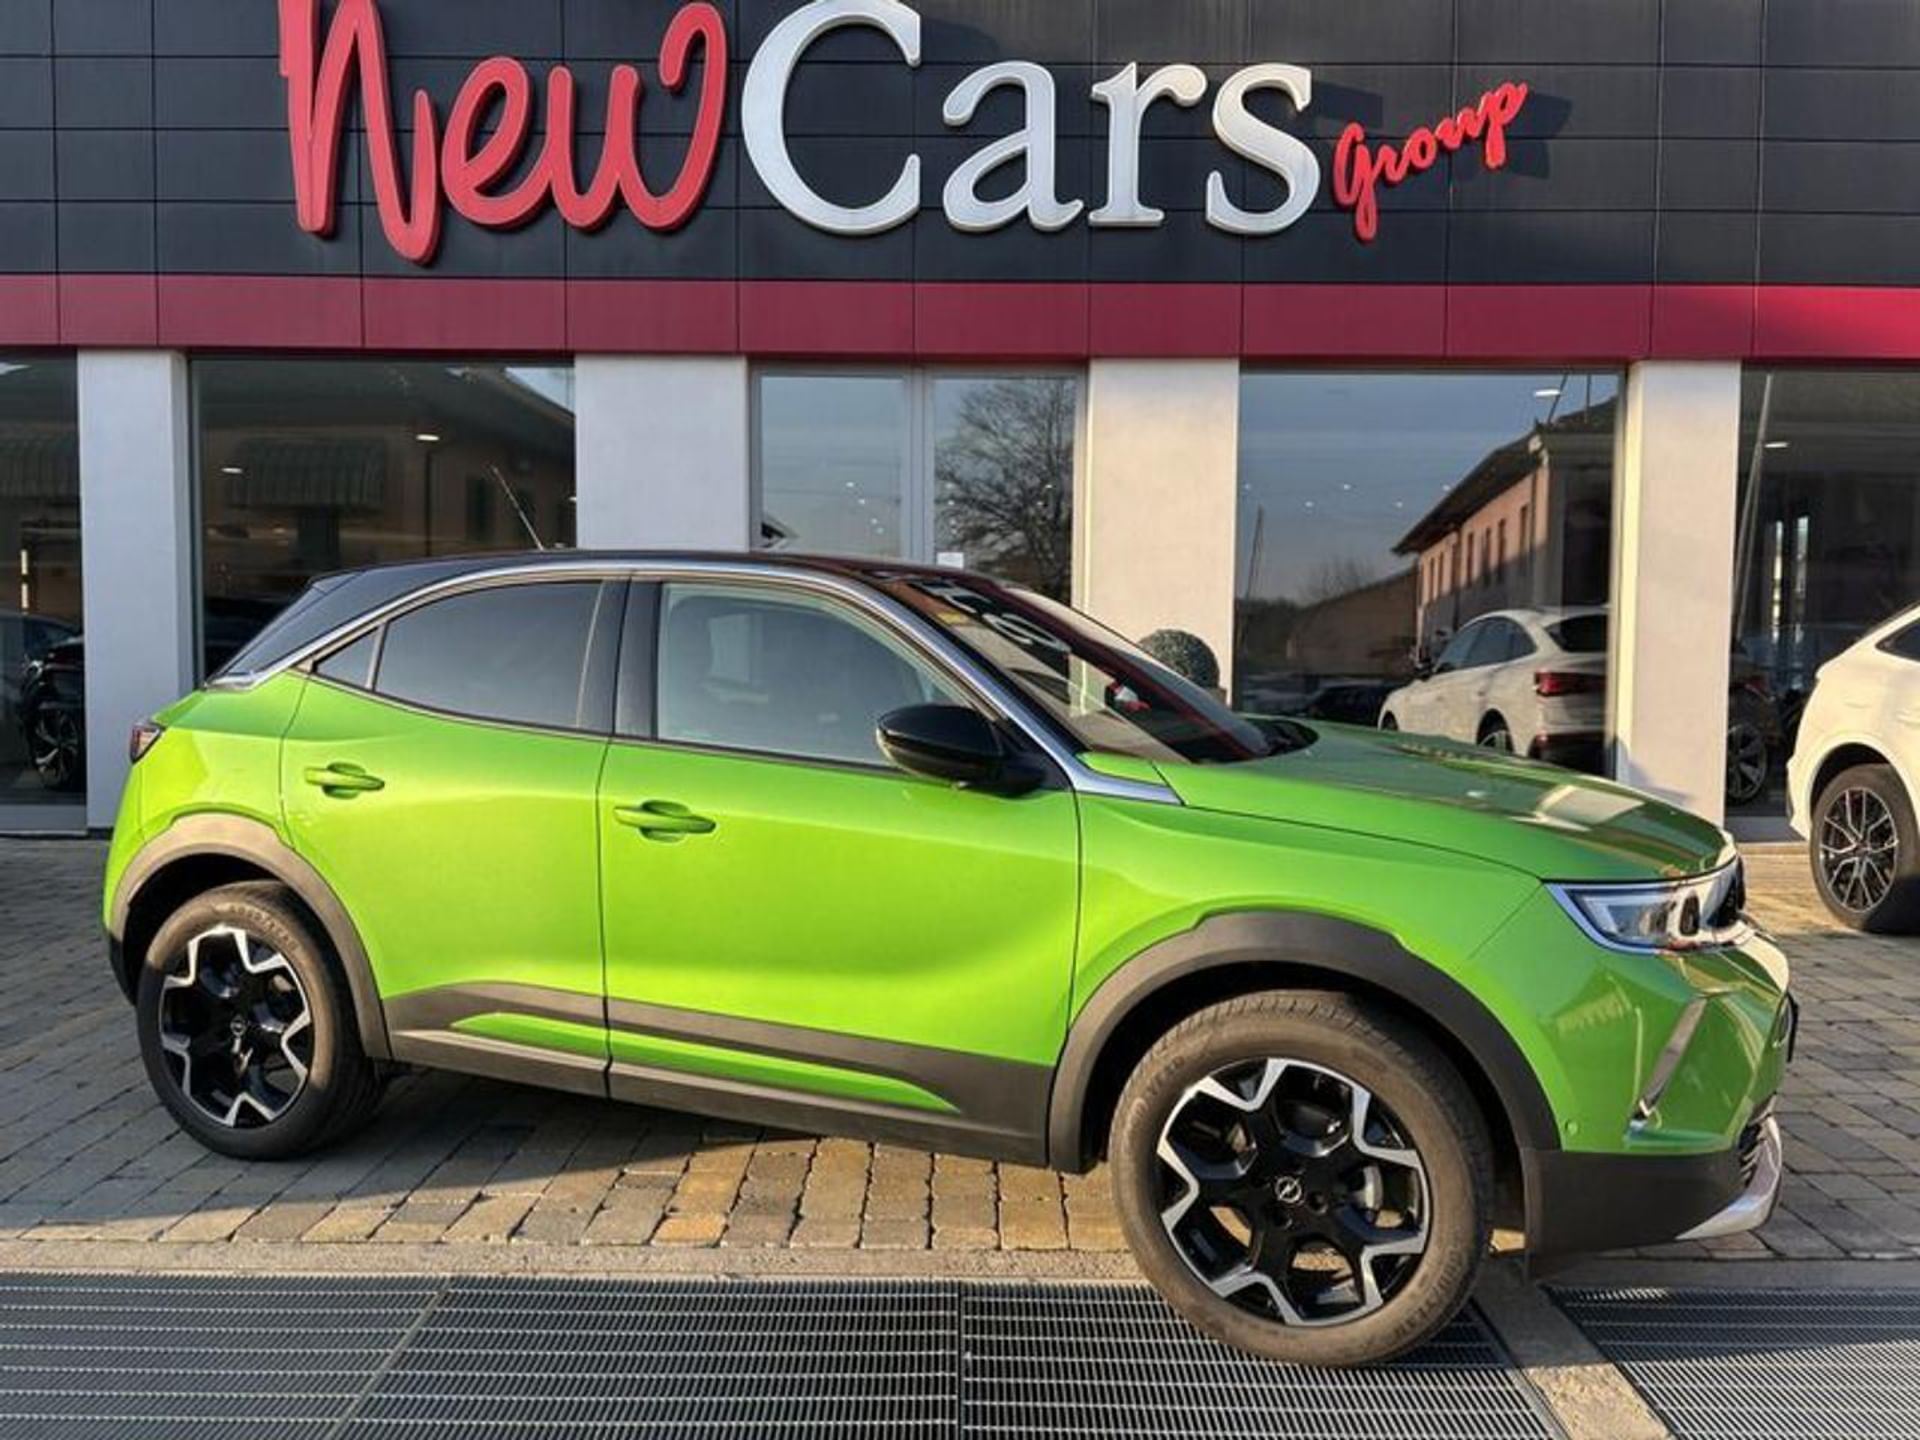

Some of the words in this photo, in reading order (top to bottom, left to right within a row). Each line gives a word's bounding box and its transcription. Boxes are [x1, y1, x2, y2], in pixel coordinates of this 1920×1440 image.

[278, 0, 728, 265] New
[741, 0, 1321, 236] Cars
[1333, 80, 1528, 241] Group
